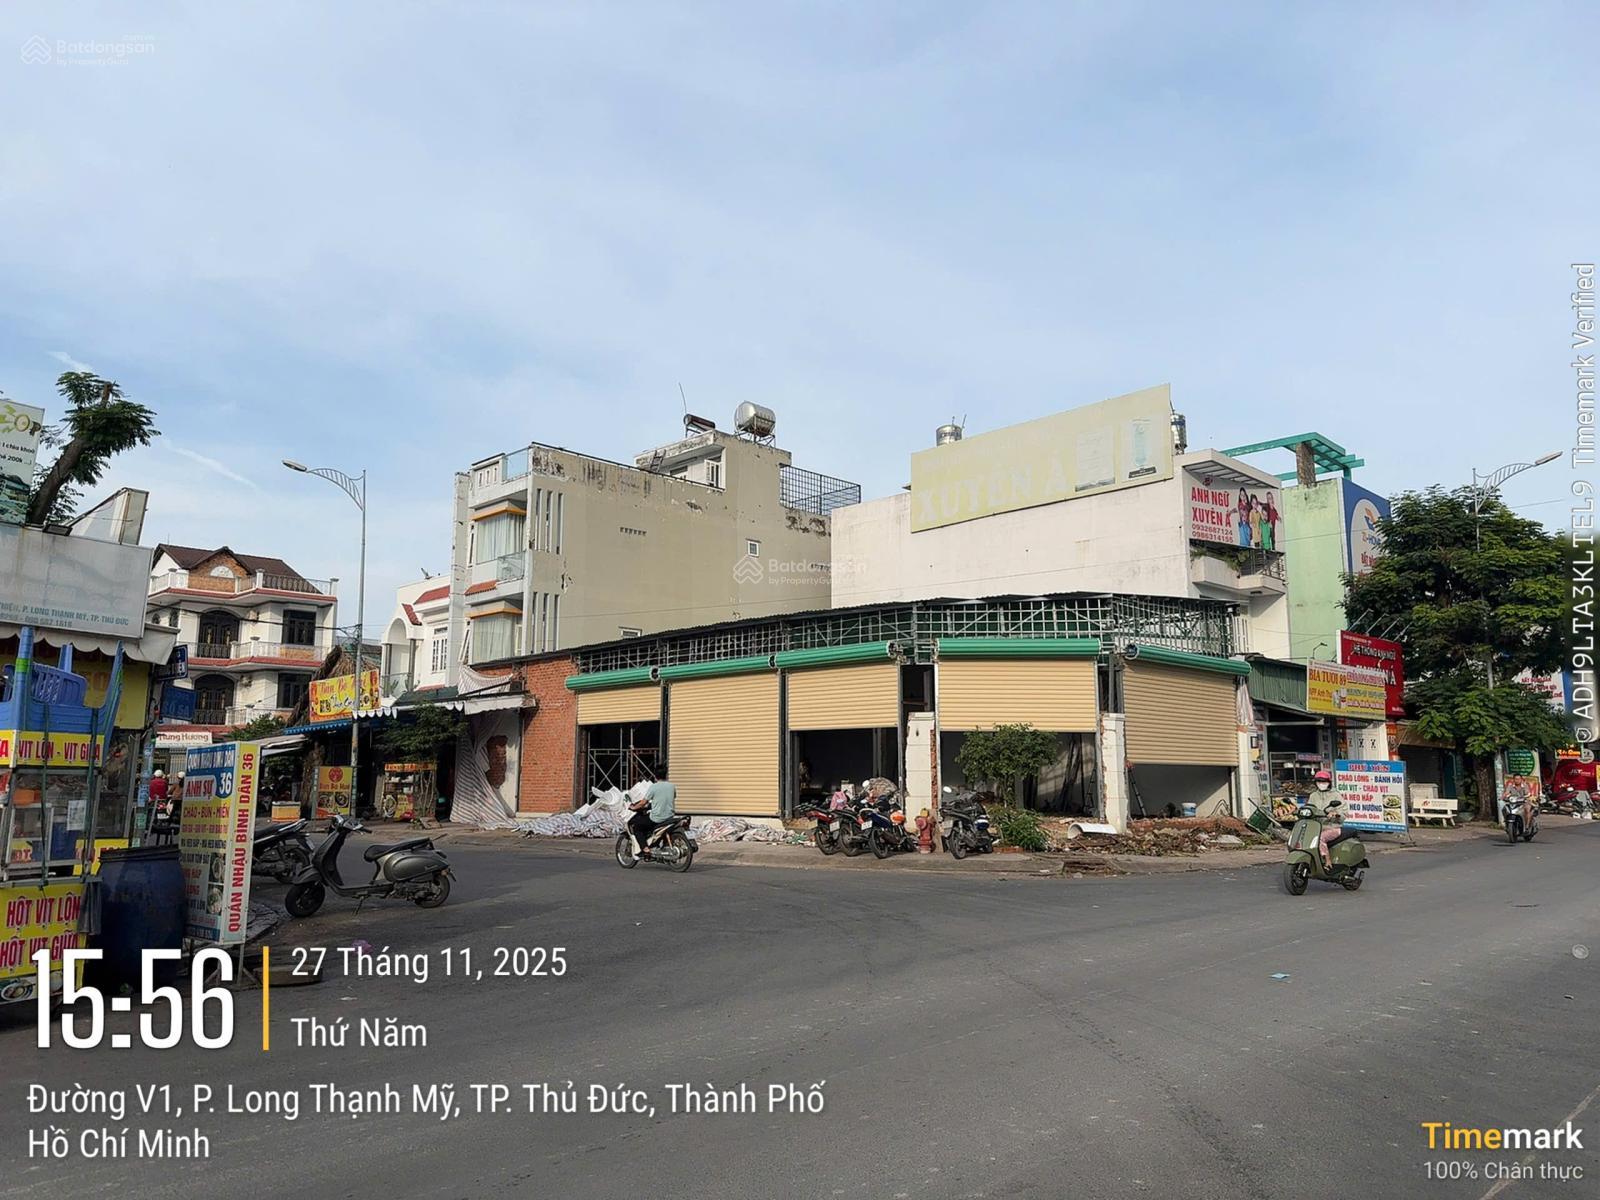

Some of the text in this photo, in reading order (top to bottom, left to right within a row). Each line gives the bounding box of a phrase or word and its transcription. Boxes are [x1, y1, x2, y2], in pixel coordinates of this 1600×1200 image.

[1191, 486, 1210, 505] ANH
[1191, 506, 1223, 526] XUYÊN
[1309, 667, 1321, 681] BIA
[19, 740, 34, 763] VỊT
[64, 742, 79, 764] VỊT
[219, 772, 232, 795] 36
[1338, 774, 1353, 782] CHÁO
[1374, 775, 1391, 784] BÁNH
[185, 780, 203, 798] ANH
[1349, 785, 1358, 793] VỊT
[1363, 785, 1378, 793] CHÁO
[1380, 786, 1389, 794] VỊT
[1349, 794, 1361, 802] HEO
[227, 753, 254, 933] QUÁN NHẬU BÌNH DÂN 36
[7, 891, 81, 931] HỘT VỊT LỘN
[0, 935, 25, 972] HỘT
